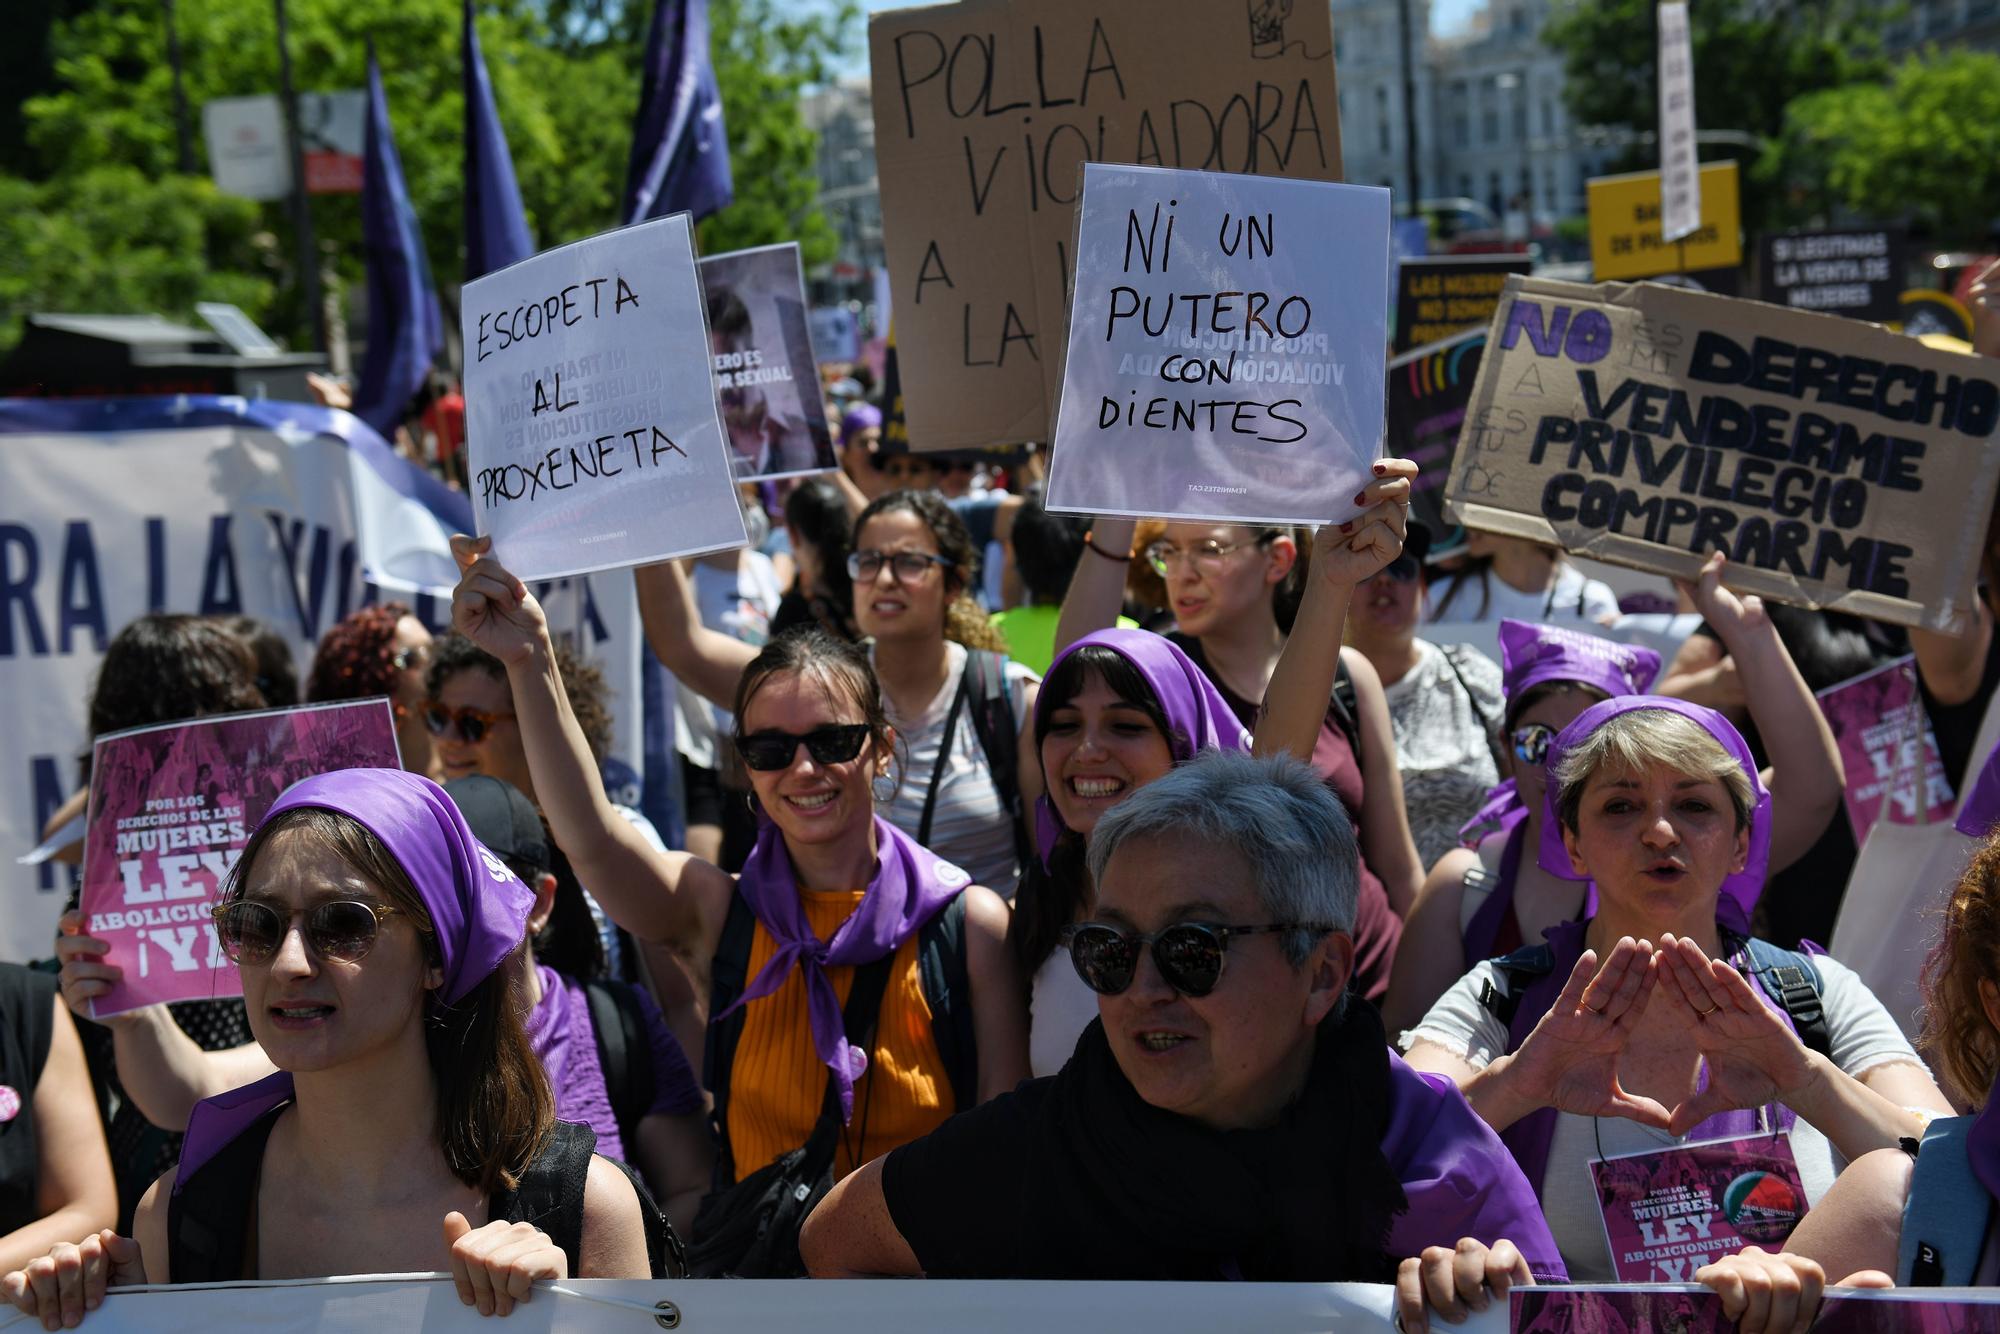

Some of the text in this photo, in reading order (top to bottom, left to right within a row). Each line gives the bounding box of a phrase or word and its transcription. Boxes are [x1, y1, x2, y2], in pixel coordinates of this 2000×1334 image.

[894, 18, 1126, 138] POLLA
[1219, 212, 1274, 260] UN
[915, 240, 954, 304] A
[477, 276, 640, 362] ESCOPETA
[965, 303, 1039, 367] LA
[1105, 286, 1311, 342] PUTERO
[735, 366, 793, 387] SEXUAL
[1160, 350, 1236, 385] CON
[1499, 299, 1613, 364] NO
[1633, 318, 1683, 347] ES
[1687, 331, 2000, 437] DERECHO
[530, 372, 579, 417] AL
[1515, 363, 1926, 492] A VENDERME
[476, 425, 688, 510] PROXENETA
[1529, 415, 1868, 529] PRIVILEGIO
[1541, 472, 1914, 599] COMPRARME
[117, 806, 241, 829] DERECHOS DE LAS
[146, 795, 206, 812] POR LOS
[119, 849, 243, 905] LEY
[1630, 1190, 1710, 1208] DERECHOS DE LAS
[1632, 1198, 1719, 1220] MUJERES,
[1650, 1185, 1688, 1197] POR LOS
[1624, 1236, 1743, 1263] ABOLICIONISTA
[1639, 1213, 1712, 1247] LEY
